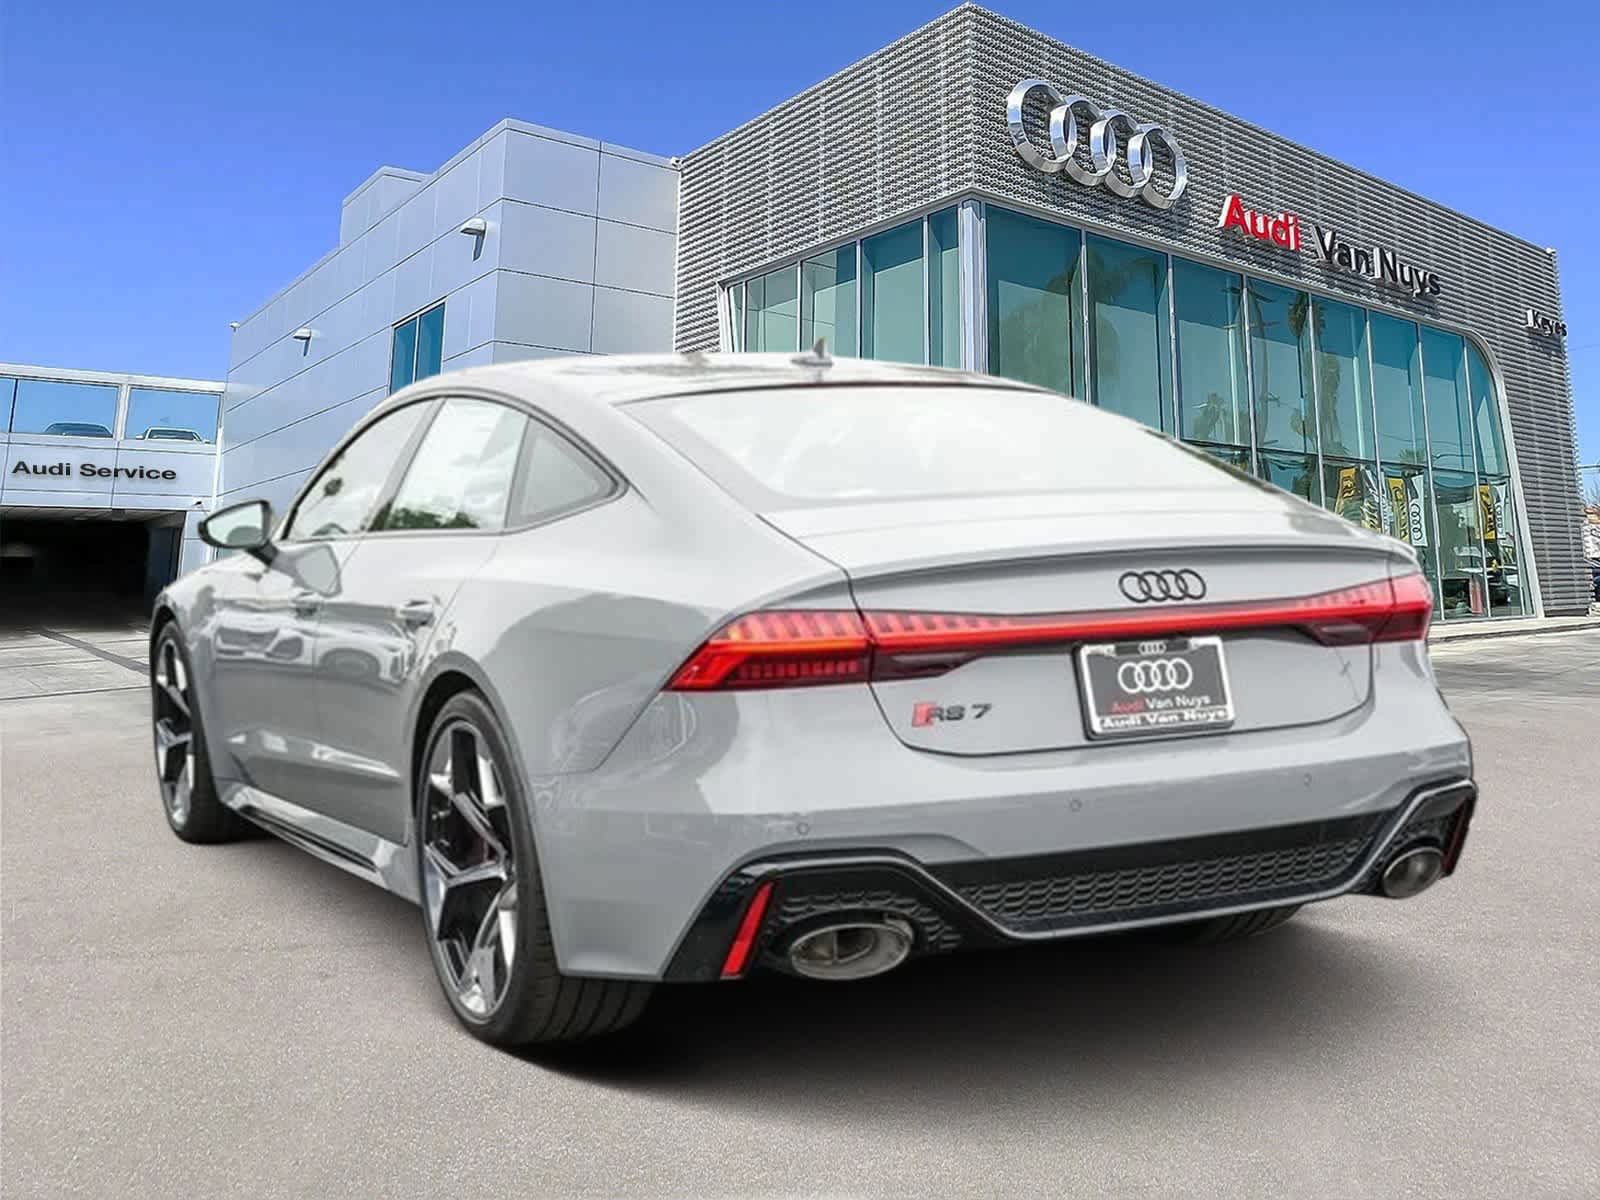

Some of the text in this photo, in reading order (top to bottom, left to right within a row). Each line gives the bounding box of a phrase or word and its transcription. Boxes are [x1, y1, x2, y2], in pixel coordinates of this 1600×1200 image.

[1218, 193, 1441, 298] Audi Van Nuys
[1527, 309, 1568, 336] Keyes
[12, 461, 177, 480] Audi Service
[1112, 695, 1211, 713] Audi Van Nuys
[1103, 709, 1227, 728] Audi Van Nuys
